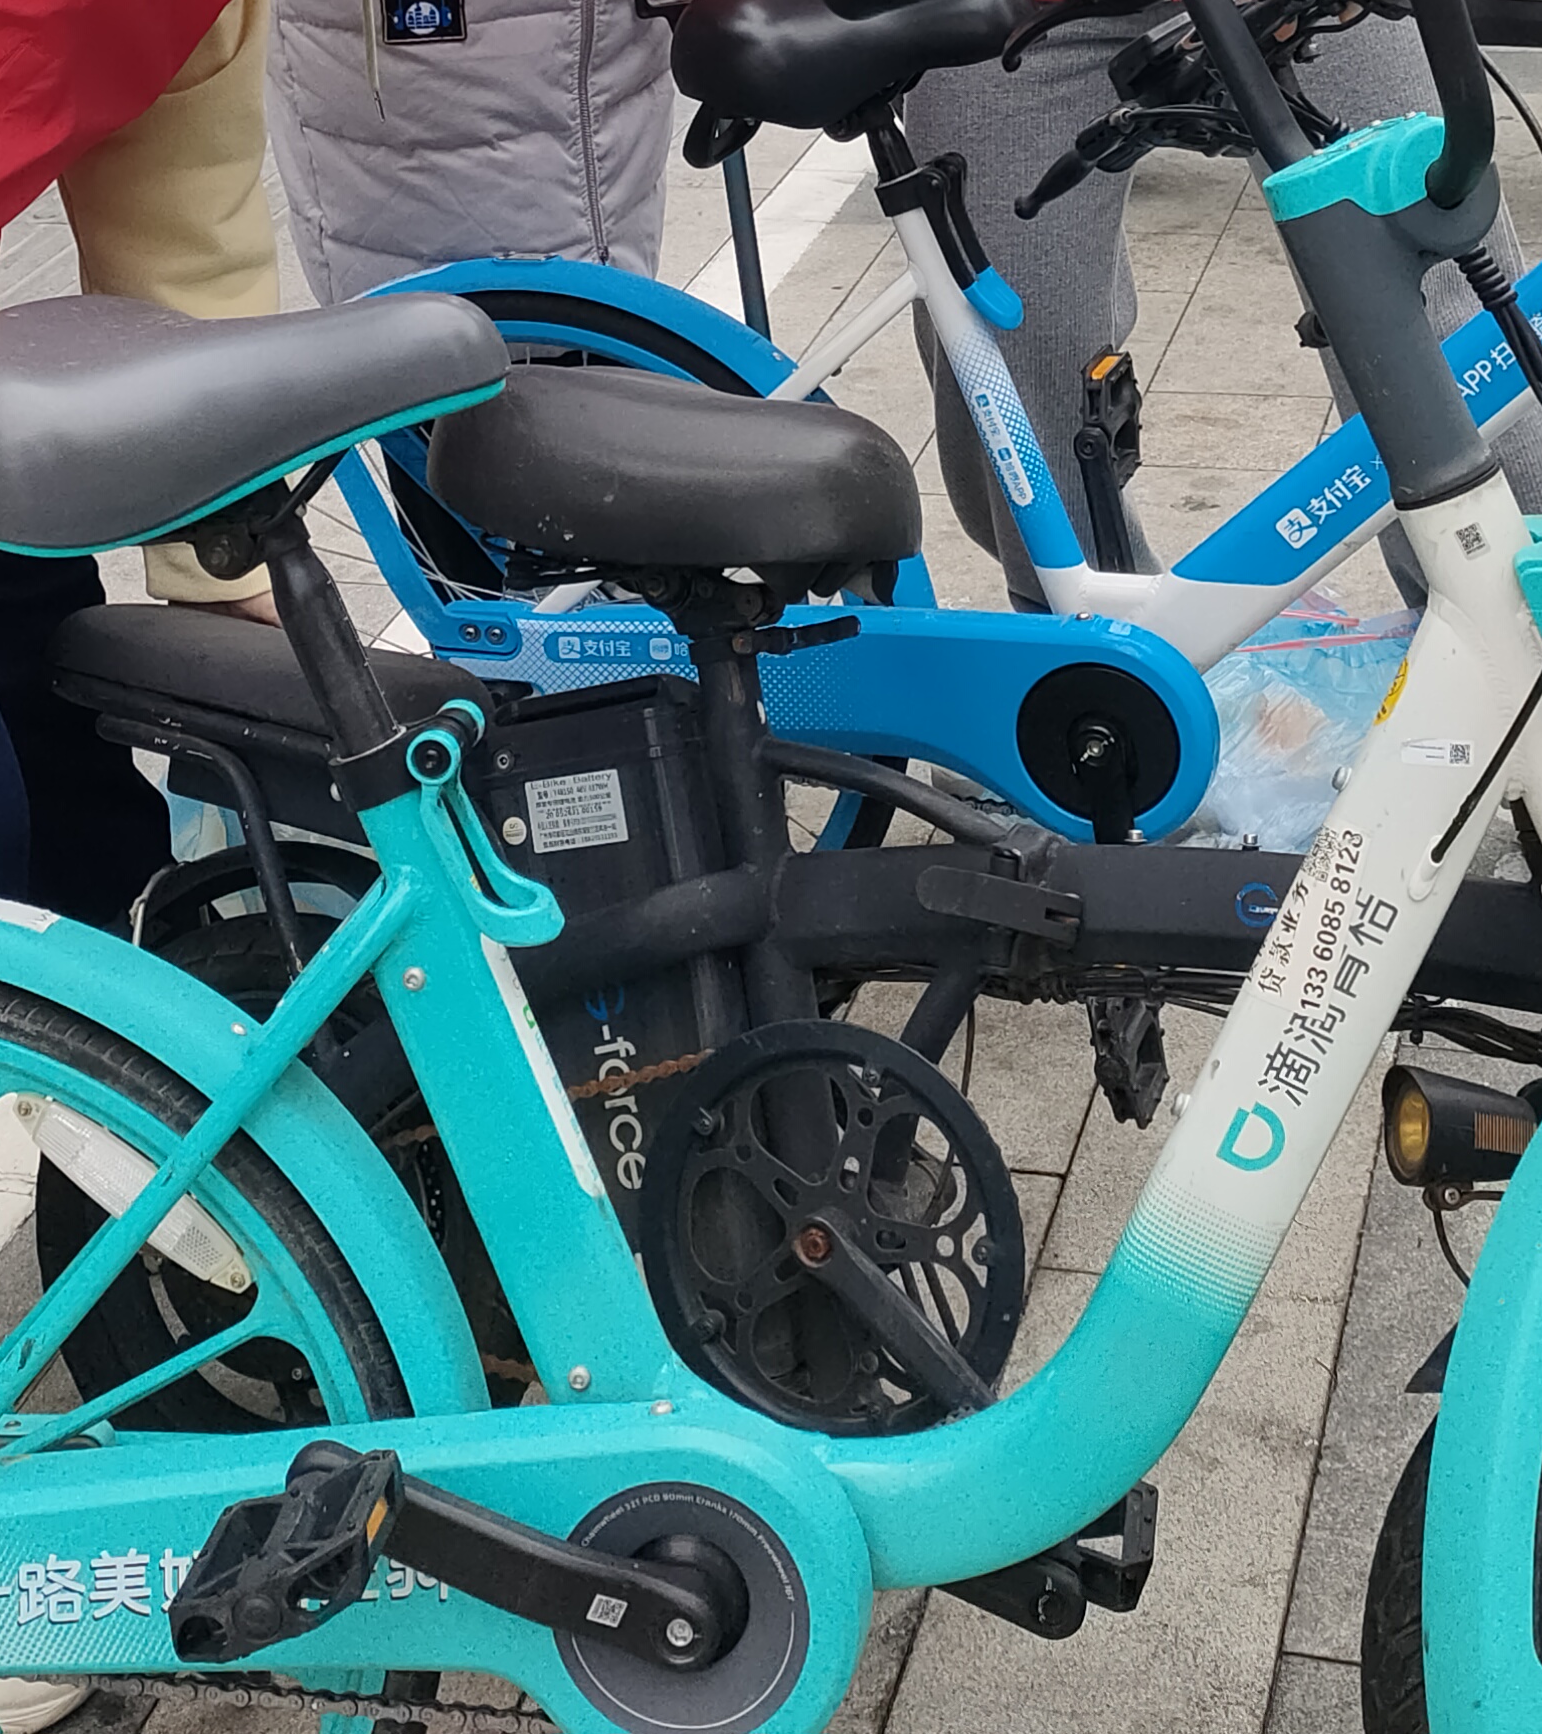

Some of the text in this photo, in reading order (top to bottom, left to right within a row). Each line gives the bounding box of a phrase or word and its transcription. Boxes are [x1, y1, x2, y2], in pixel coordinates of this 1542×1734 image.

[1306, 464, 1373, 525] 支付宝
[583, 639, 632, 657] 支付宝
[573, 772, 613, 784] Battery
[1257, 882, 1310, 998] 贷款业务
[1313, 897, 1345, 962] 6085
[1300, 966, 1329, 1009] 133
